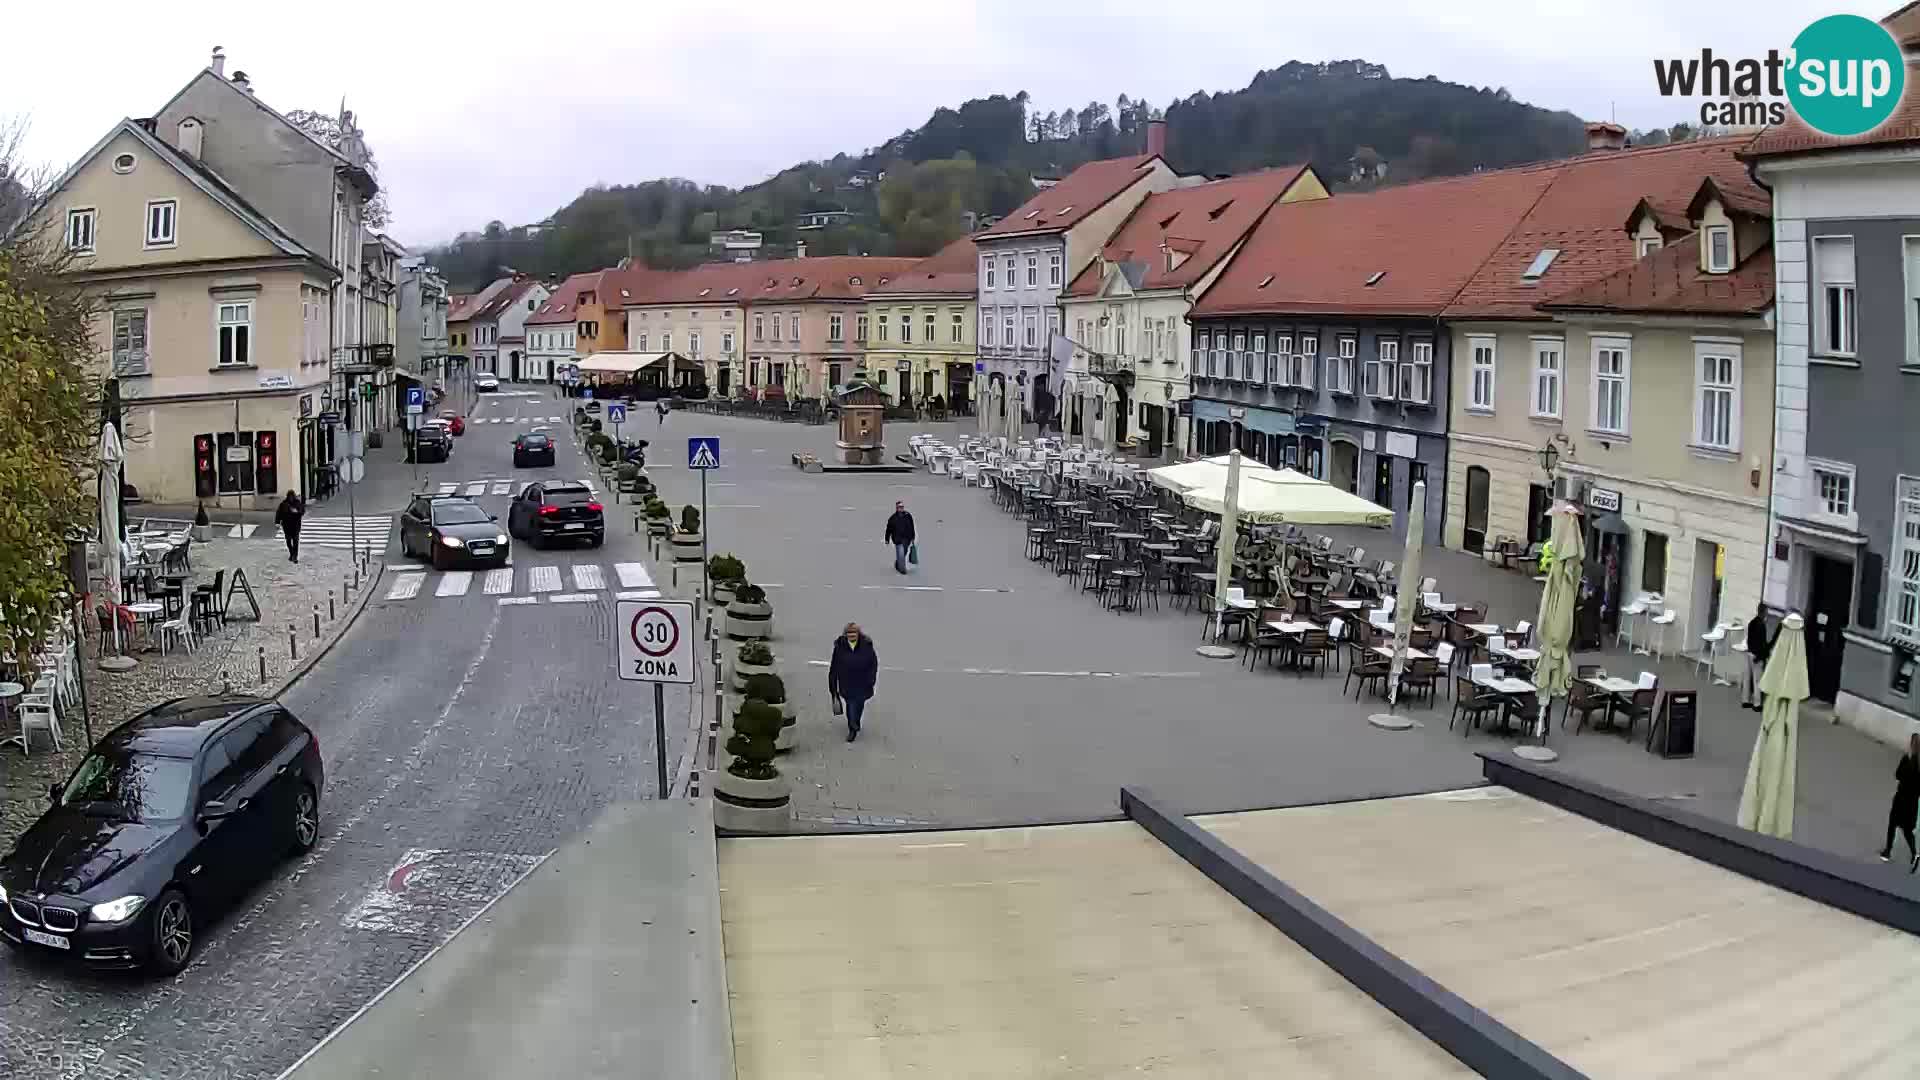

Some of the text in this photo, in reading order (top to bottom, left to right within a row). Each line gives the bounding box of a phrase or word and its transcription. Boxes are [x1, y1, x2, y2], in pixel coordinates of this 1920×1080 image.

[411, 391, 420, 403] P
[643, 622, 668, 644] 30
[634, 659, 678, 676] ZONA
